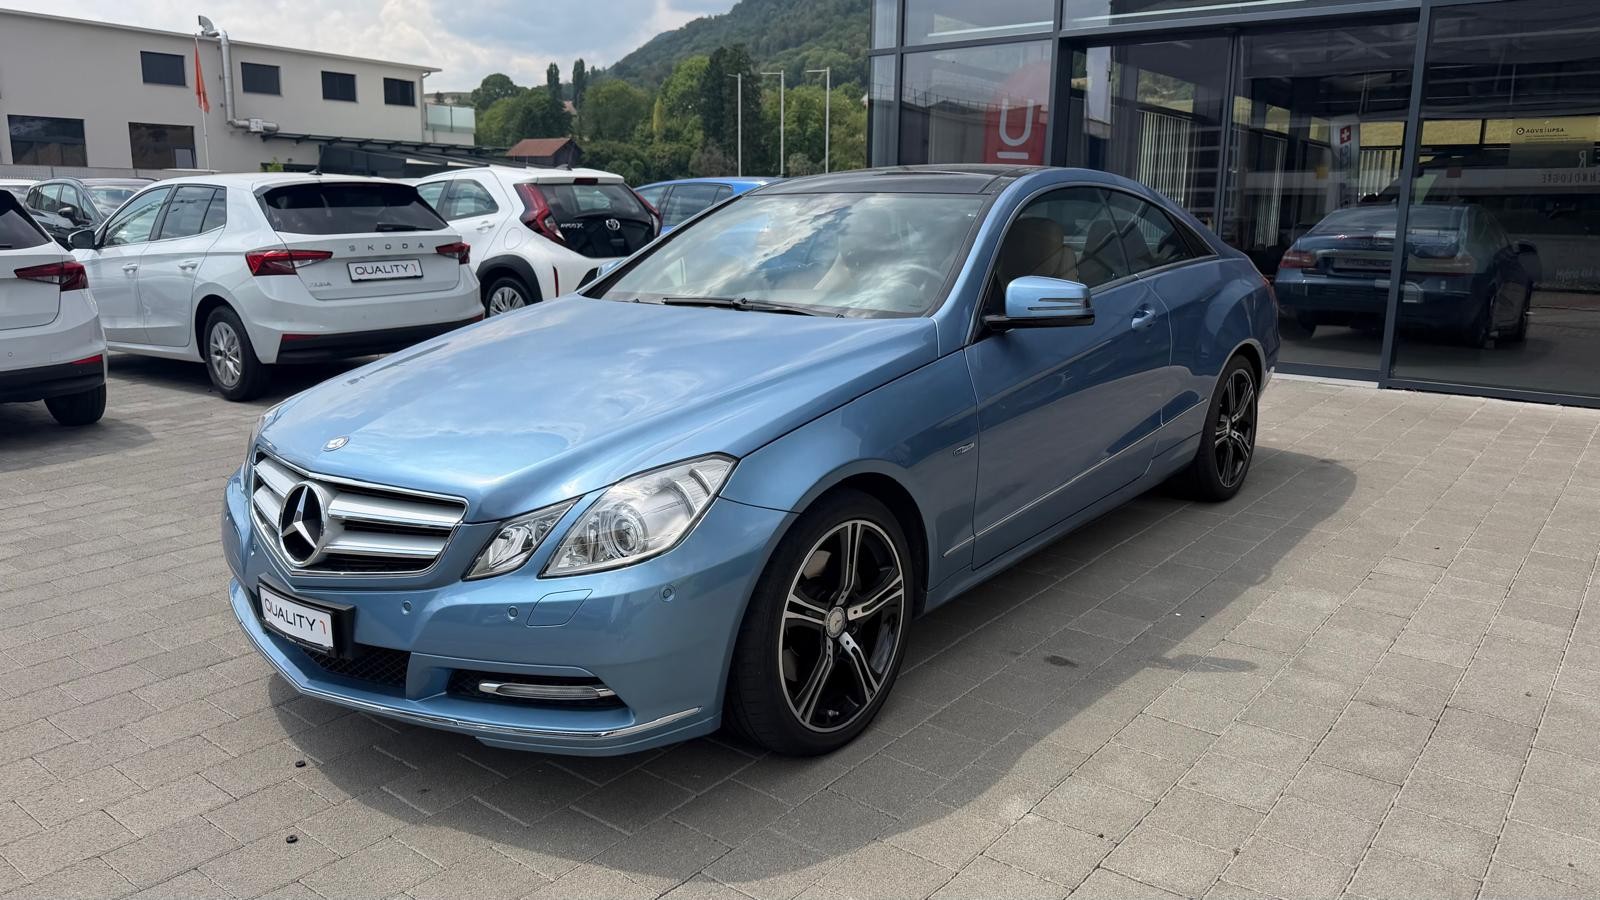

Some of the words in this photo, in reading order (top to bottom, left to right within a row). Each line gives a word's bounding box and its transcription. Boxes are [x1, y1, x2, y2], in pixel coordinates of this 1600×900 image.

[354, 264, 409, 275] QUALITY
[411, 263, 417, 273] 1
[264, 598, 316, 632] QUALITY
[319, 618, 327, 635] 1
